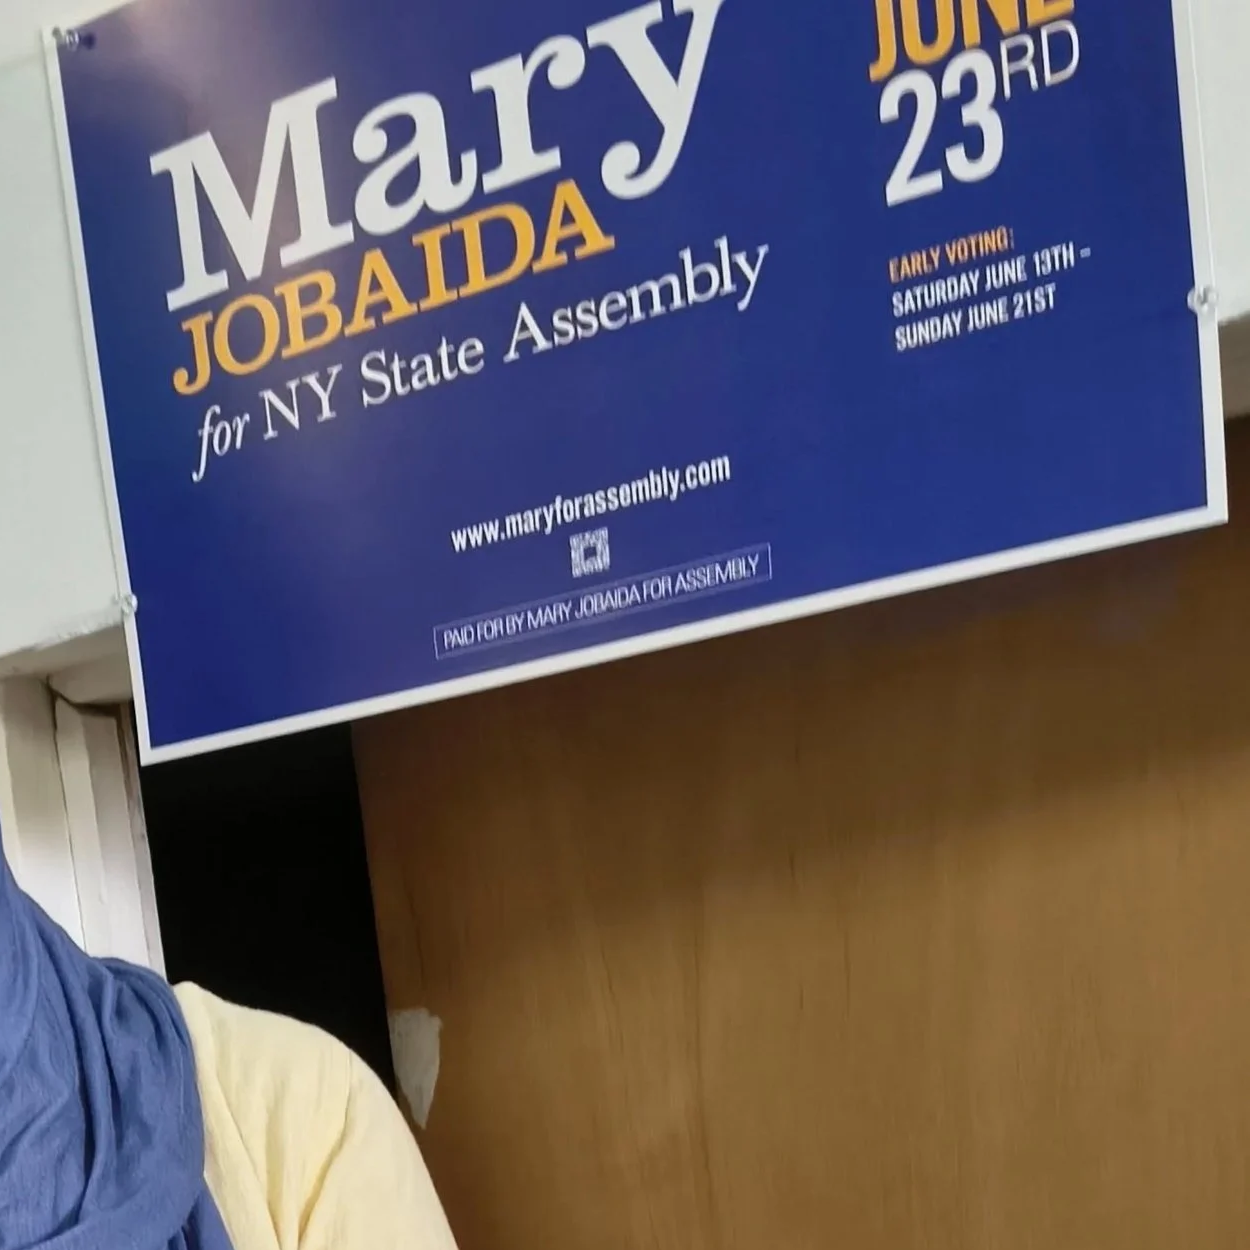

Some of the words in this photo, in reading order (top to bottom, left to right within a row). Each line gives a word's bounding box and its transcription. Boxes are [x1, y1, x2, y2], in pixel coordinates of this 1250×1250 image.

[869, 0, 1075, 82] JU
[150, 0, 726, 311] Mary
[172, 178, 614, 395] JOBAIDA
[889, 244, 941, 284] EARLY
[892, 268, 981, 318] SATURDAY
[985, 254, 1027, 292] JUNE
[1032, 240, 1075, 278] 13TH
[191, 403, 251, 484] for
[258, 363, 343, 441] NY
[360, 335, 485, 408] State
[503, 235, 769, 363] Assembly
[895, 308, 963, 352] SUNDAY
[967, 295, 1009, 332] JUNE
[1013, 281, 1057, 320] 21ST
[451, 454, 731, 552] www.maryforassembly.com
[443, 623, 476, 651] PAID
[477, 616, 504, 643] FOR
[506, 611, 526, 637] BY
[527, 600, 573, 631] MARY
[575, 583, 641, 620] JOBAIDA
[643, 573, 673, 603] FOR
[675, 552, 760, 597] ASSEMBLY
